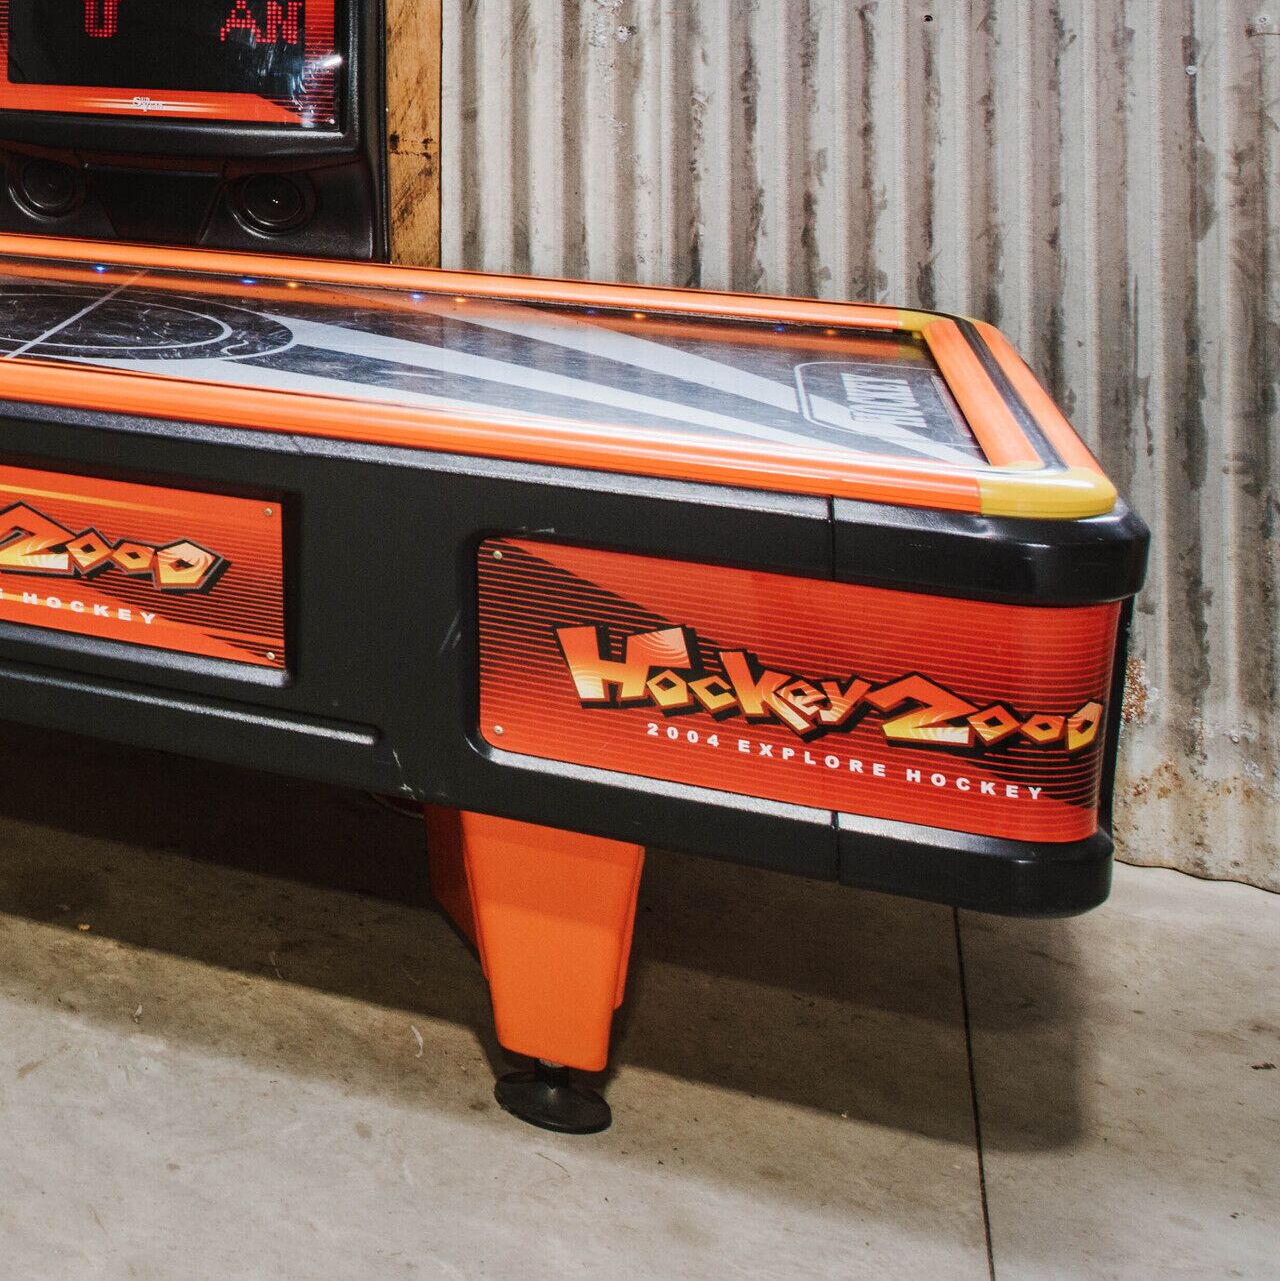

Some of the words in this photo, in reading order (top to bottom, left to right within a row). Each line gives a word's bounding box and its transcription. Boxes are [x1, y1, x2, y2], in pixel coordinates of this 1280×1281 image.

[22, 593, 157, 626] HOCKEY
[646, 722, 720, 748] 2004
[737, 738, 887, 778] EXPLORE
[905, 768, 1043, 801] HOCKEY
